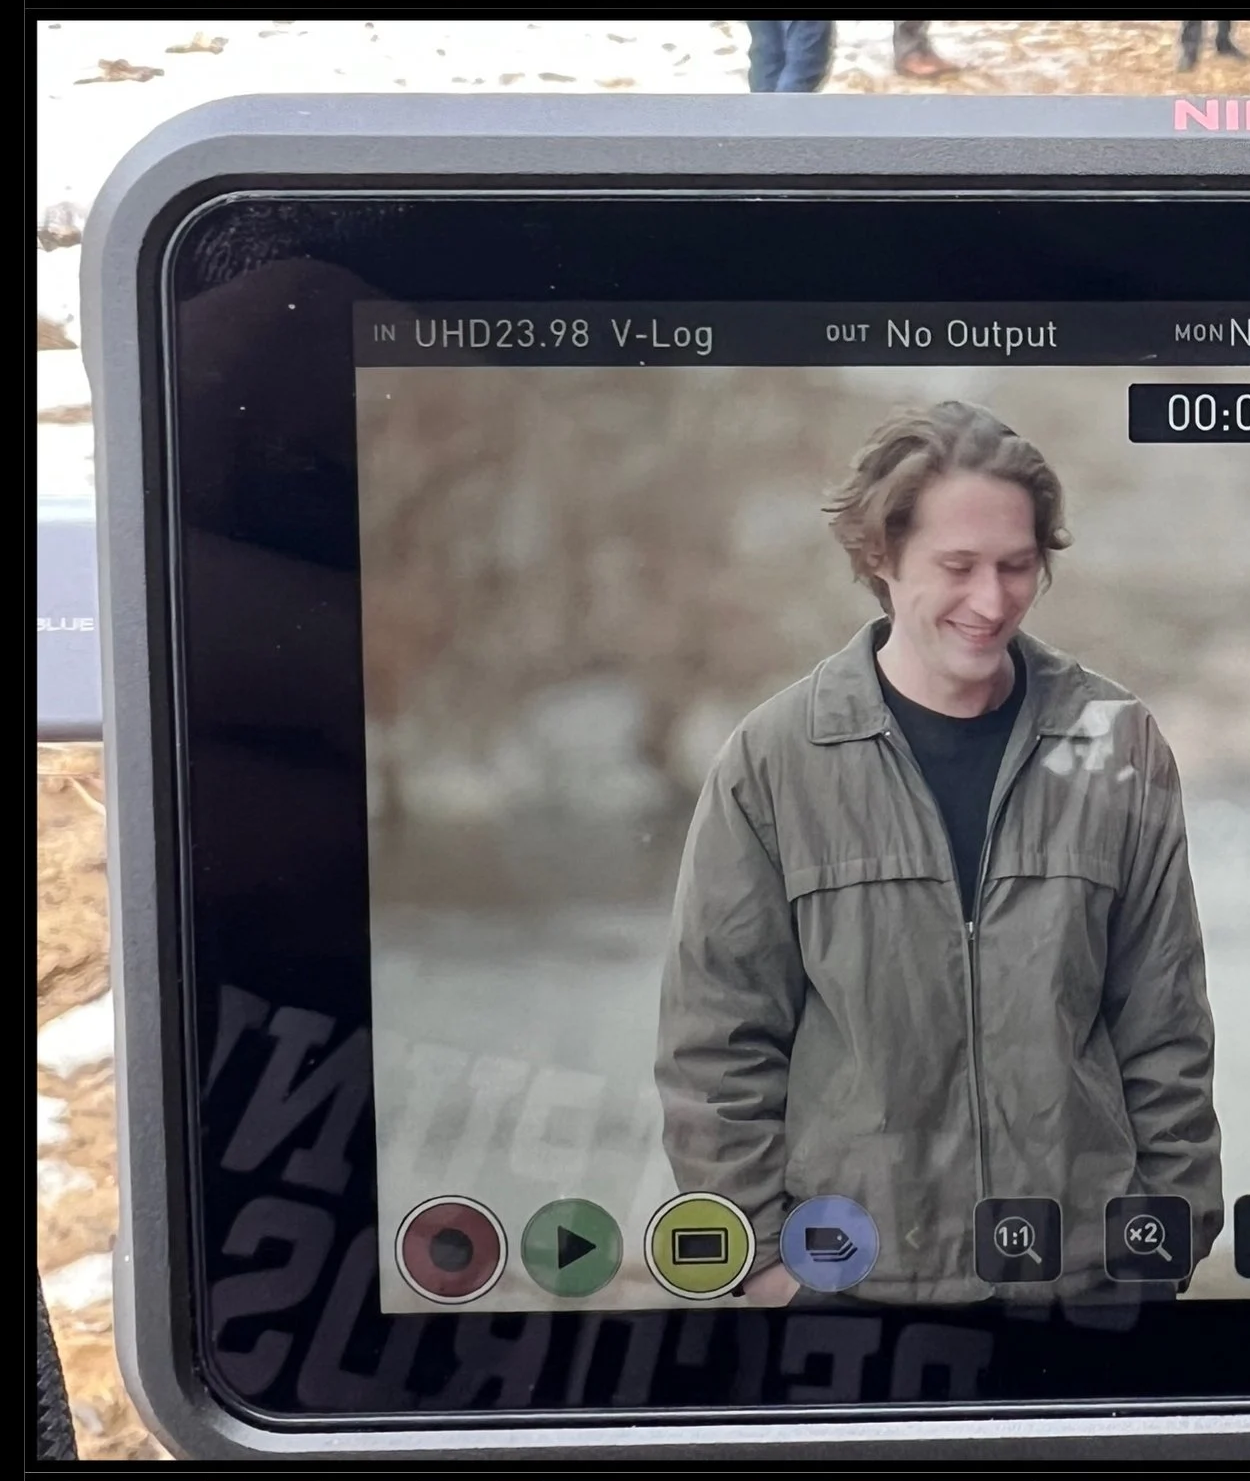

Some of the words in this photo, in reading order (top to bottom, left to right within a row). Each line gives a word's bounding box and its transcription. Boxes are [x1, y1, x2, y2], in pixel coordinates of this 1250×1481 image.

[373, 324, 396, 342] IN
[414, 319, 590, 348] UHD23.98
[611, 319, 714, 355] V-Log
[825, 324, 870, 342] OUT
[886, 320, 932, 347] No
[946, 320, 1058, 355] Output
[1174, 324, 1224, 342] MON
